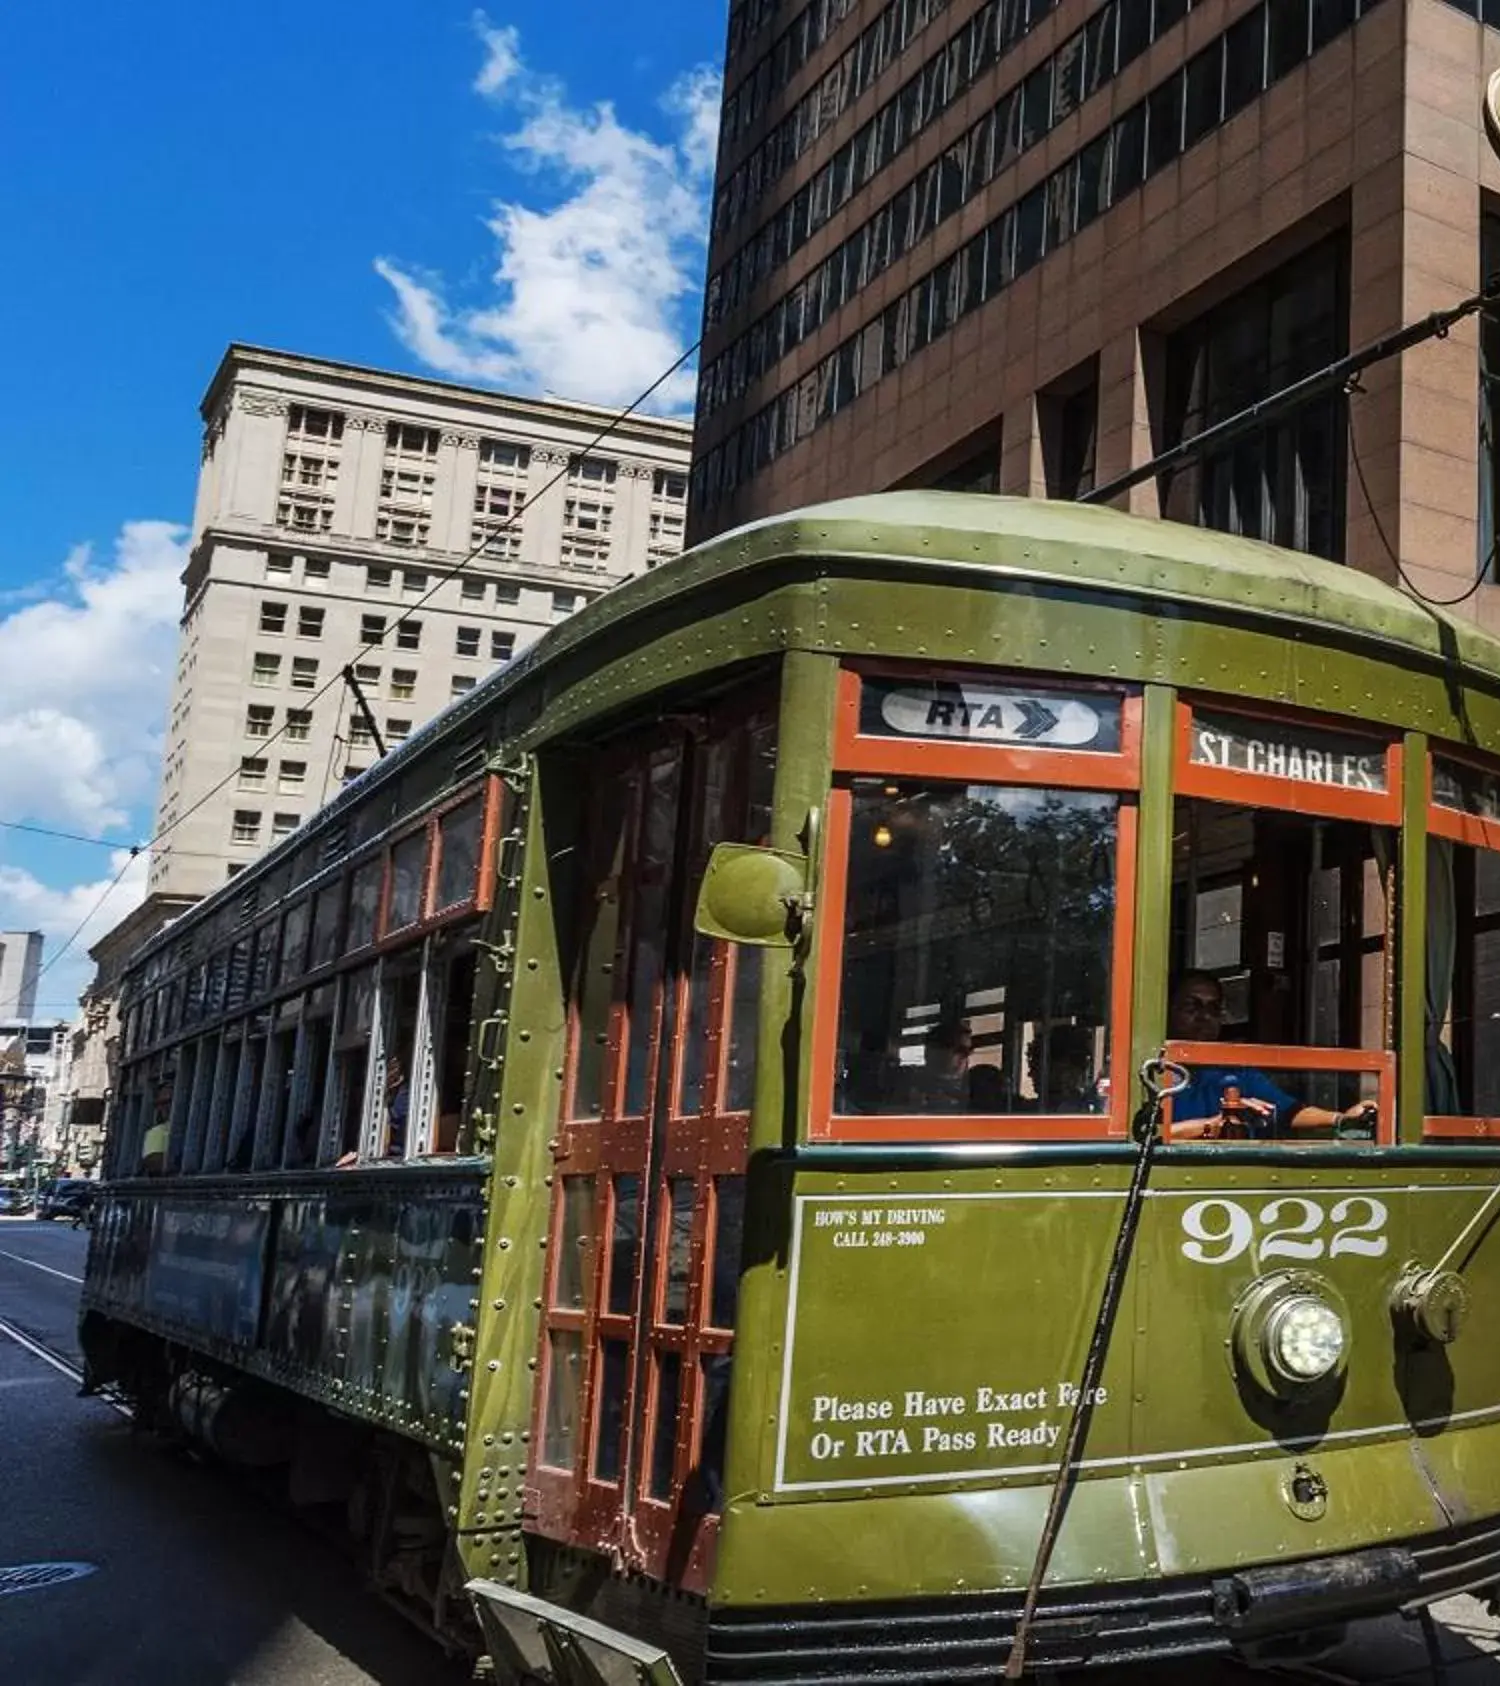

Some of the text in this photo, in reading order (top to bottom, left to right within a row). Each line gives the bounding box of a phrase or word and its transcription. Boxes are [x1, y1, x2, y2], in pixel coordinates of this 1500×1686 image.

[925, 699, 1005, 730] RTA
[1199, 731, 1373, 792] ST CHARLES
[815, 1208, 946, 1227] HOW'S MY DRIVING
[1181, 1197, 1388, 1264] 922
[833, 1231, 869, 1248] CALL
[812, 1396, 893, 1423] Please
[903, 1390, 966, 1417] Have
[976, 1385, 1047, 1413] Exact
[811, 1420, 1061, 1460] Or RTA Pass Ready
